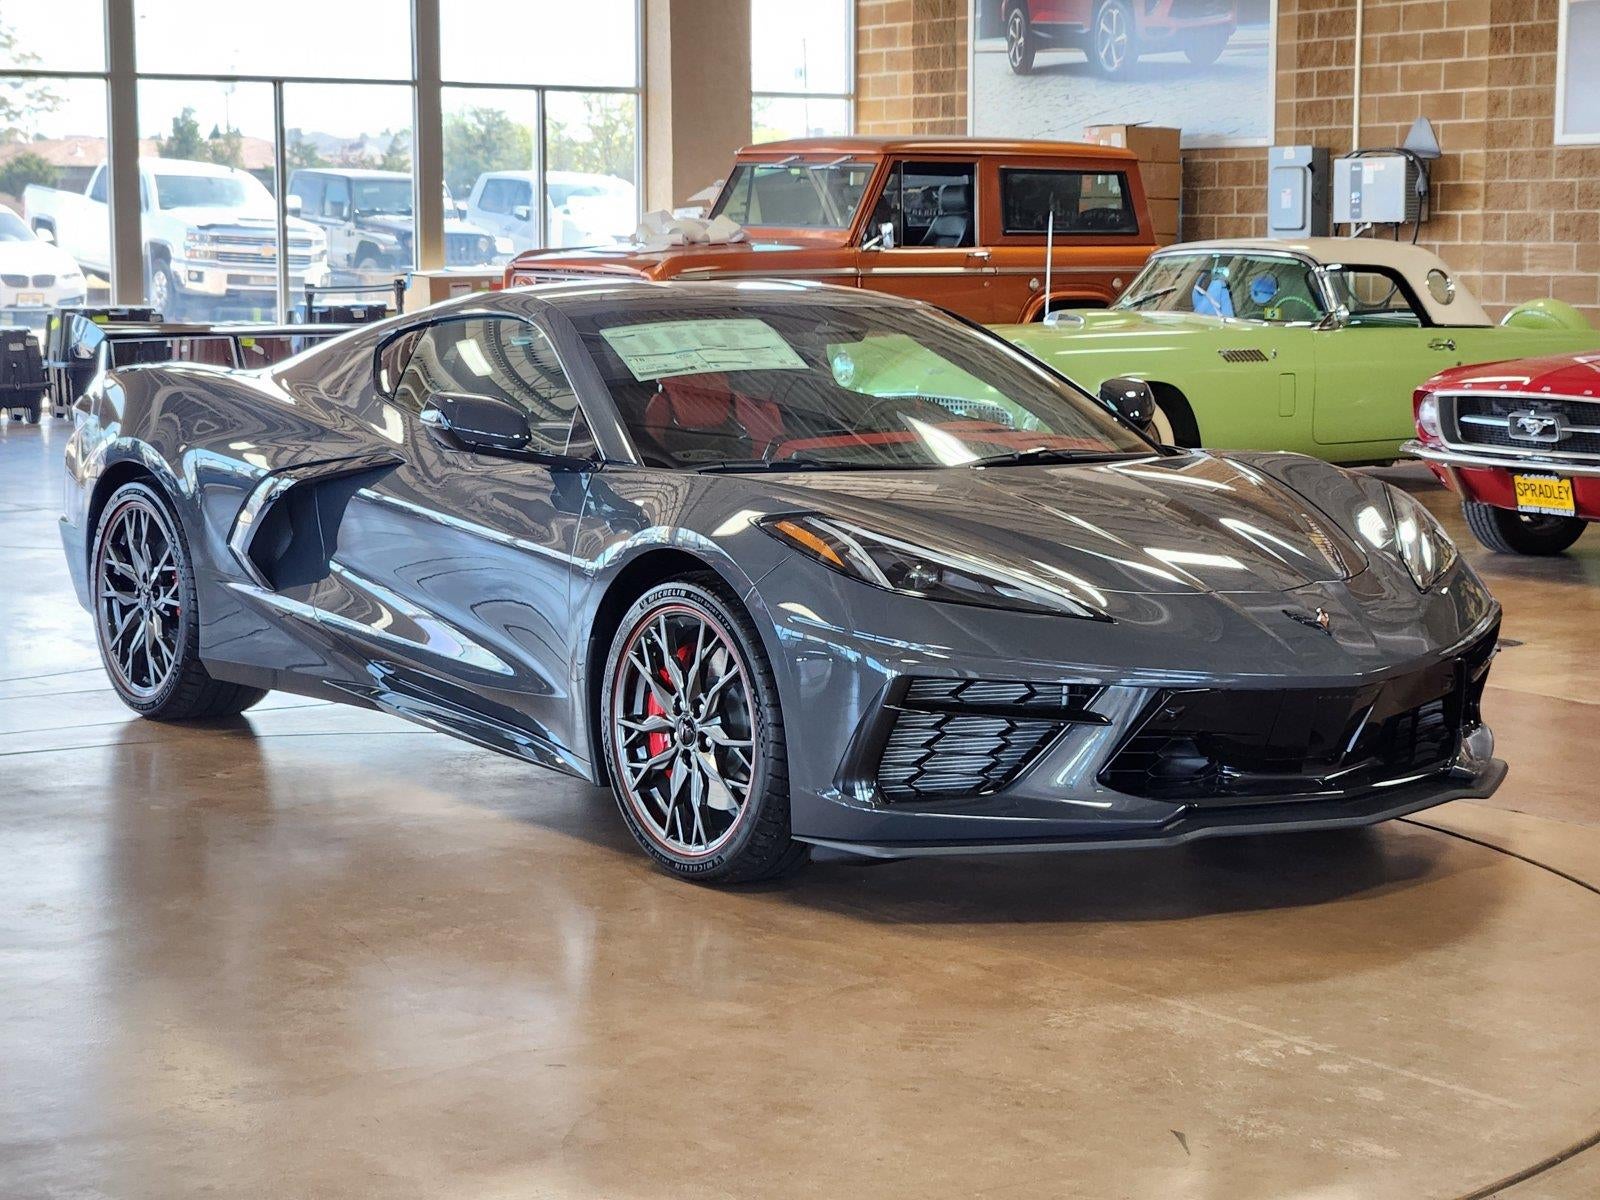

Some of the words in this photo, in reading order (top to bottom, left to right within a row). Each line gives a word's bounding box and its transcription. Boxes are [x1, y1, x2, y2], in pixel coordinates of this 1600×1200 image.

[1517, 482, 1570, 500] SPRADLEY
[648, 589, 687, 603] MICHELIN
[704, 601, 720, 615] SPORT
[674, 861, 713, 871] MICHELIN
